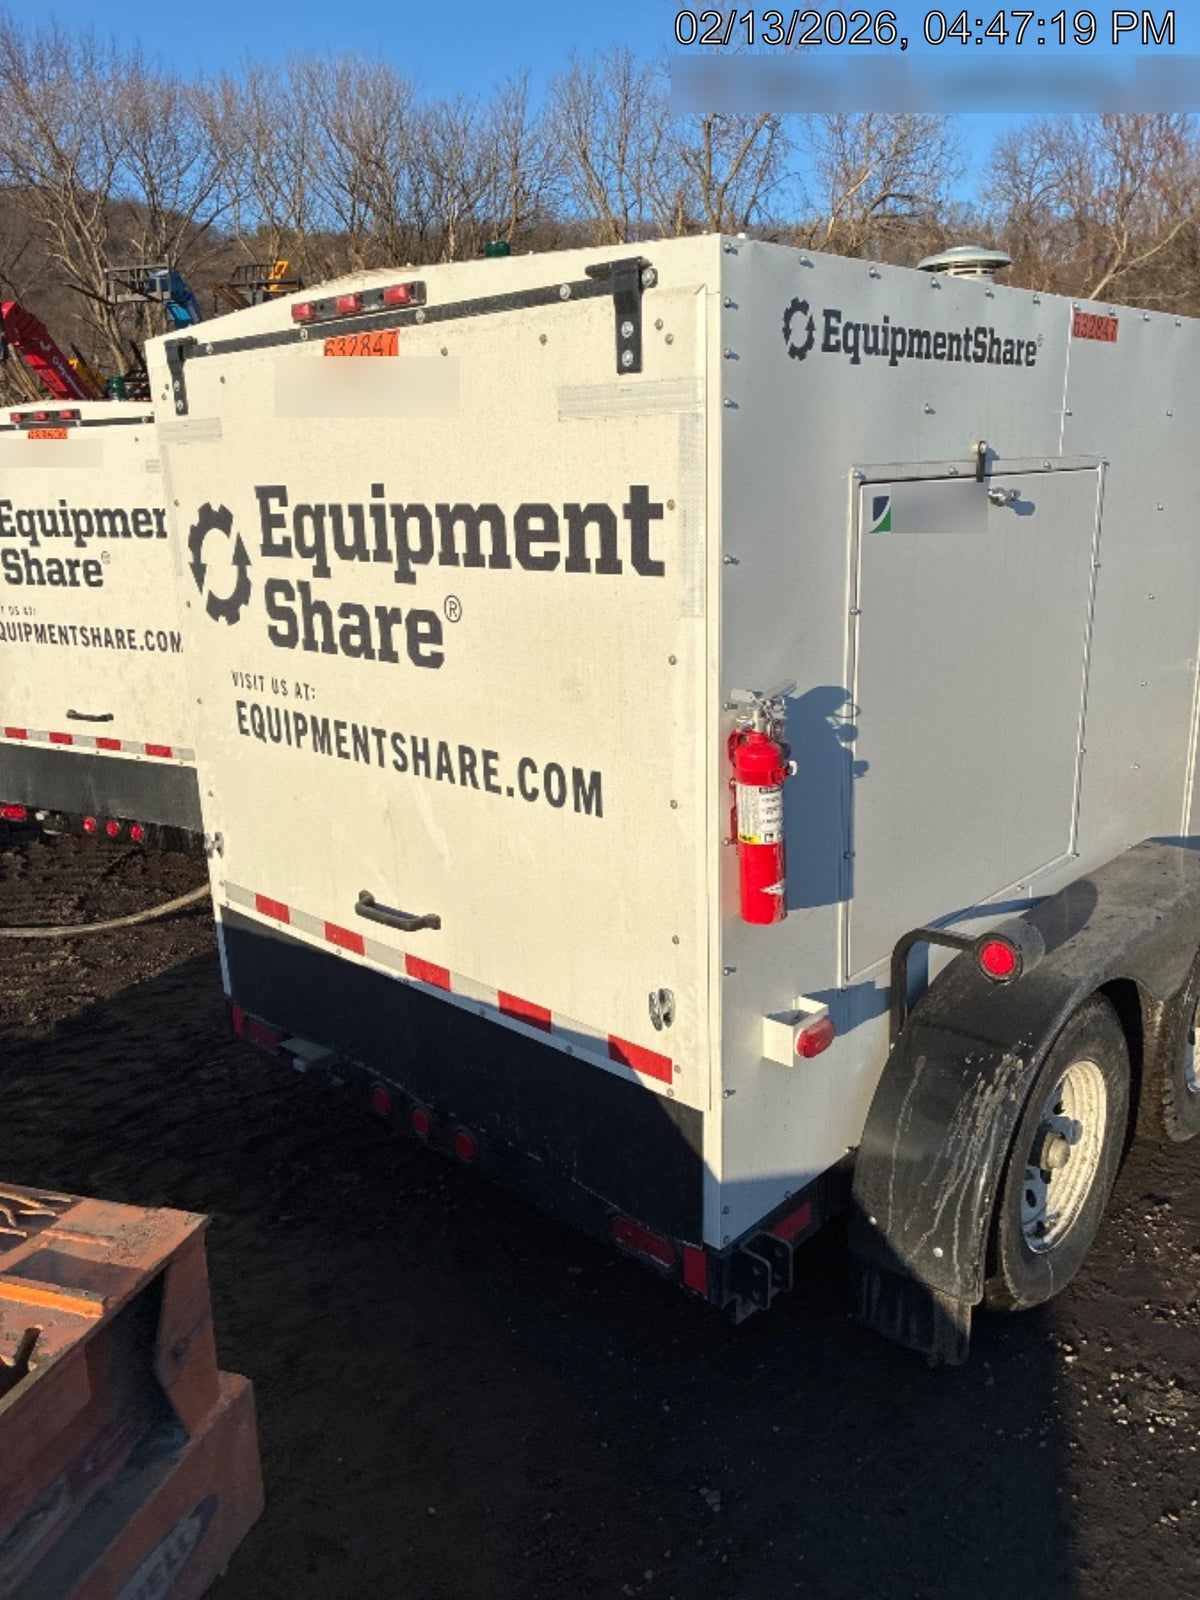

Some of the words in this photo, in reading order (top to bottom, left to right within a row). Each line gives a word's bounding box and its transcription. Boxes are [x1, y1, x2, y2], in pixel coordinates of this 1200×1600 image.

[821, 308, 1037, 367] EquipmentShare
[254, 483, 666, 585] Equipment
[231, 670, 265, 692] VISIT
[271, 678, 289, 696] US
[294, 682, 316, 701] AT:
[235, 700, 604, 819] EQUIPMENTSHARE.COM
